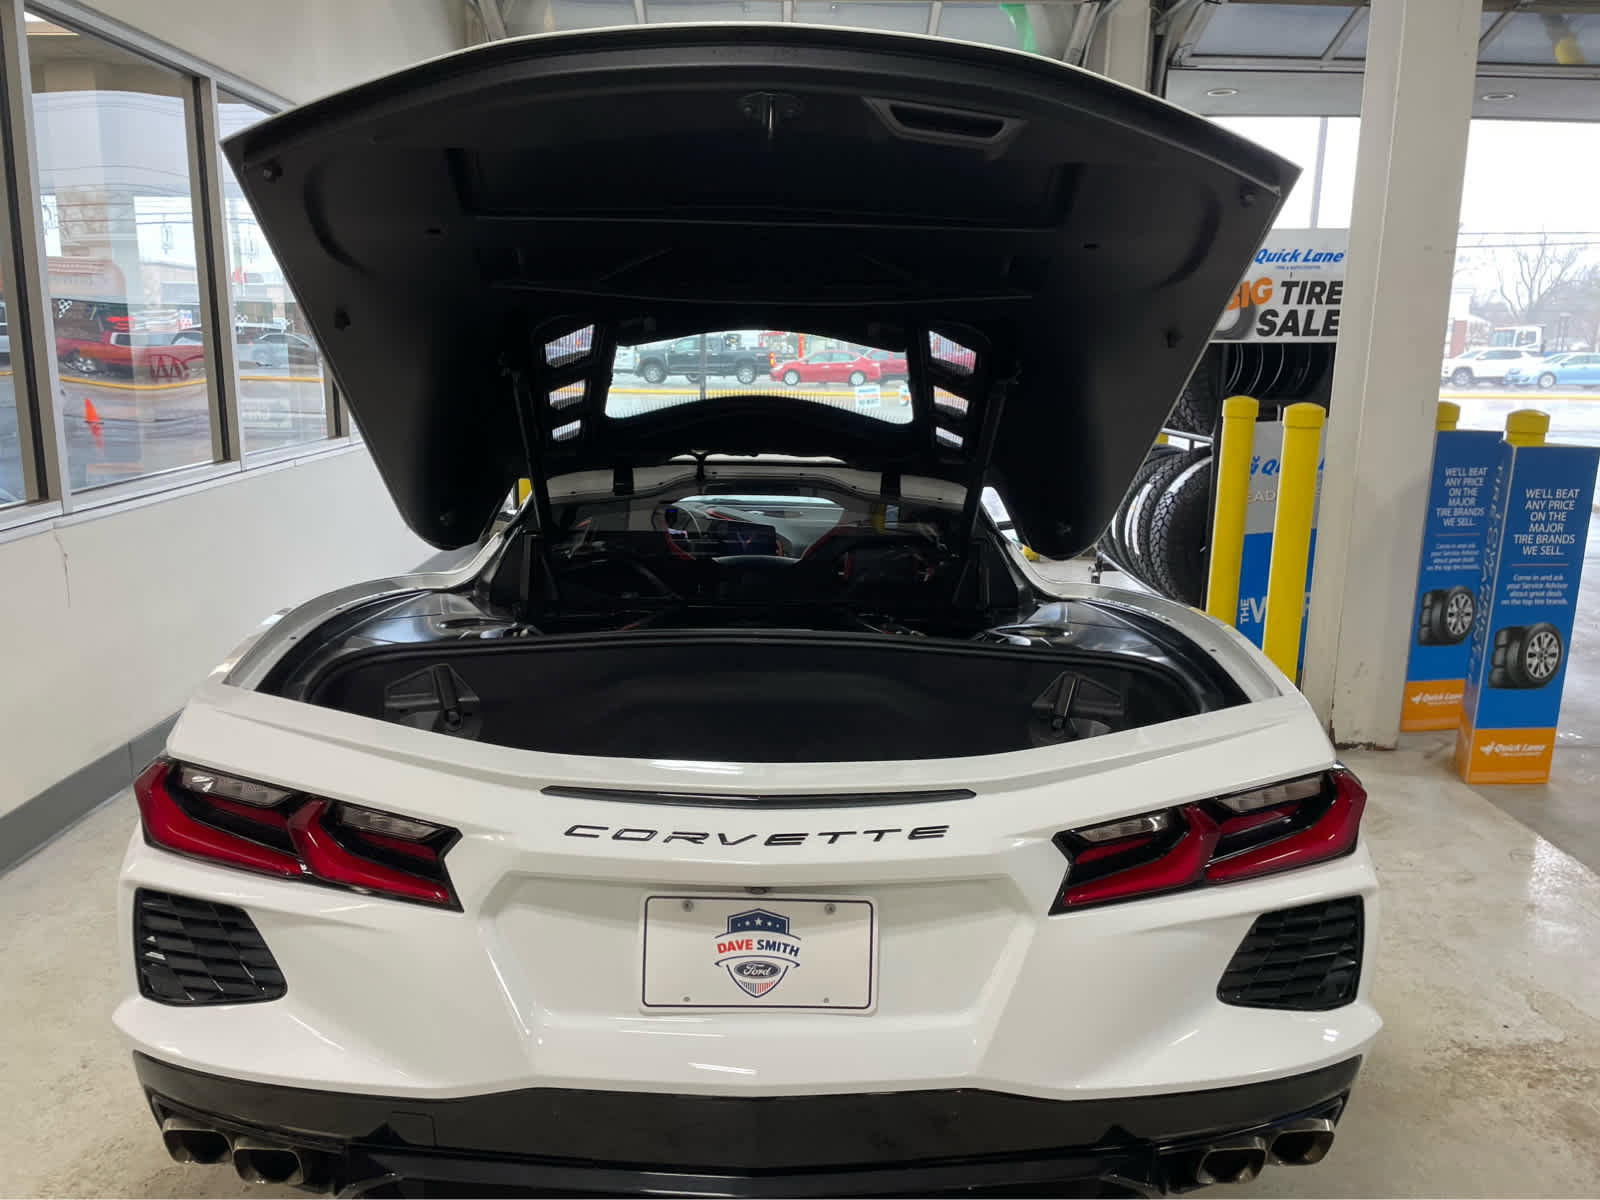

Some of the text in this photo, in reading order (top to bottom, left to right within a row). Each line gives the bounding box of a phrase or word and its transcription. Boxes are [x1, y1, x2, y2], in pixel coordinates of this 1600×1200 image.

[1255, 248, 1344, 264] Quick Lane
[1281, 280, 1343, 305] TIRE
[1256, 309, 1340, 337] SALE
[1469, 467, 1488, 476] BEAT
[1444, 477, 1485, 487] ANY PRICE
[1448, 488, 1478, 497] ON THE
[1525, 488, 1580, 499] WE'LL BEAT
[1448, 498, 1476, 507] MAJOR
[1525, 500, 1576, 511] ANY PRICE
[1436, 507, 1485, 517] TIRE BRANDS
[1530, 511, 1567, 522] ON THE
[1443, 518, 1456, 527] WE
[1528, 523, 1564, 533] MAJOR
[1513, 534, 1576, 544] TIRE BRANDS
[1522, 545, 1565, 556] WE SELL.
[1240, 598, 1249, 624] THE
[1495, 743, 1546, 752] Quick Lane
[564, 824, 950, 846] CORVETTE
[717, 938, 800, 958] DAVE SMITH
[743, 963, 772, 977] Ford
